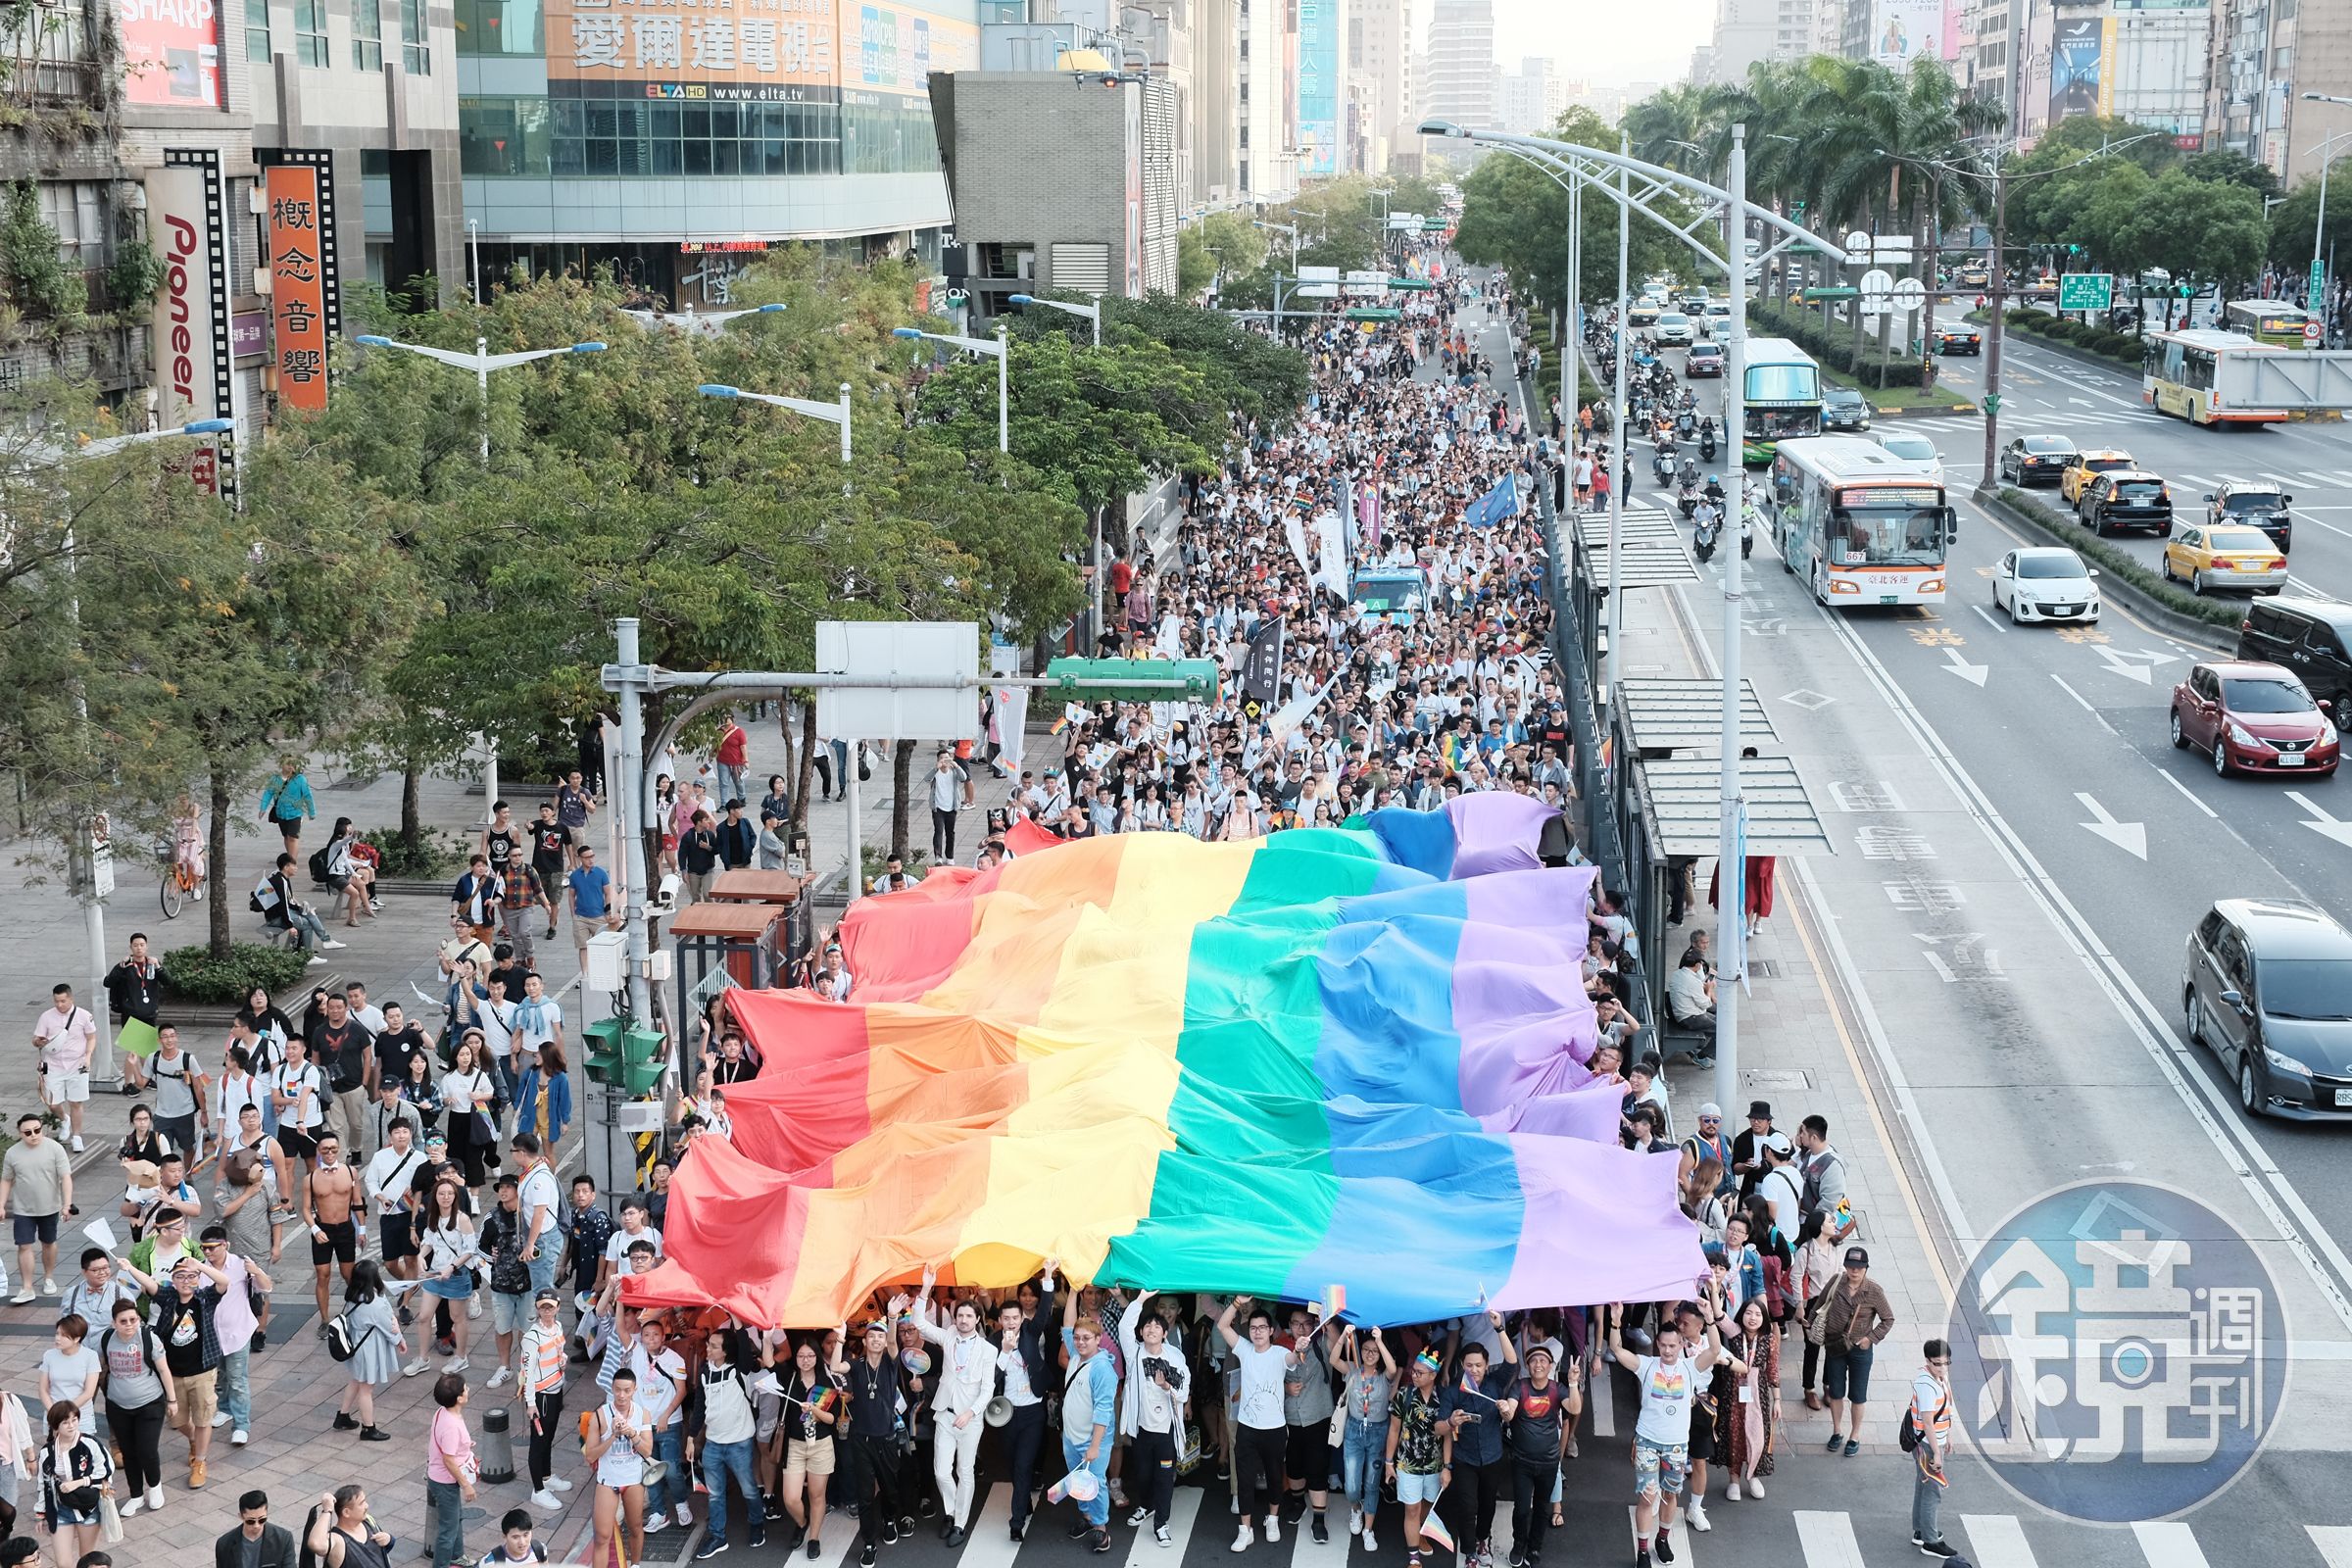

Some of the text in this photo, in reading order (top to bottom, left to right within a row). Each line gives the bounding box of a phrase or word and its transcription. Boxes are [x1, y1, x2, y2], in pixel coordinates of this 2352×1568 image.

[121, 0, 213, 29] SHARP
[571, 13, 832, 75] 愛爾達電視台
[646, 84, 804, 101] ELTA HD www.elta.tv
[272, 196, 320, 385] 概念音響
[164, 214, 197, 405] Pioneer
[1846, 552, 1864, 561] 667
[1371, 600, 1382, 611] A
